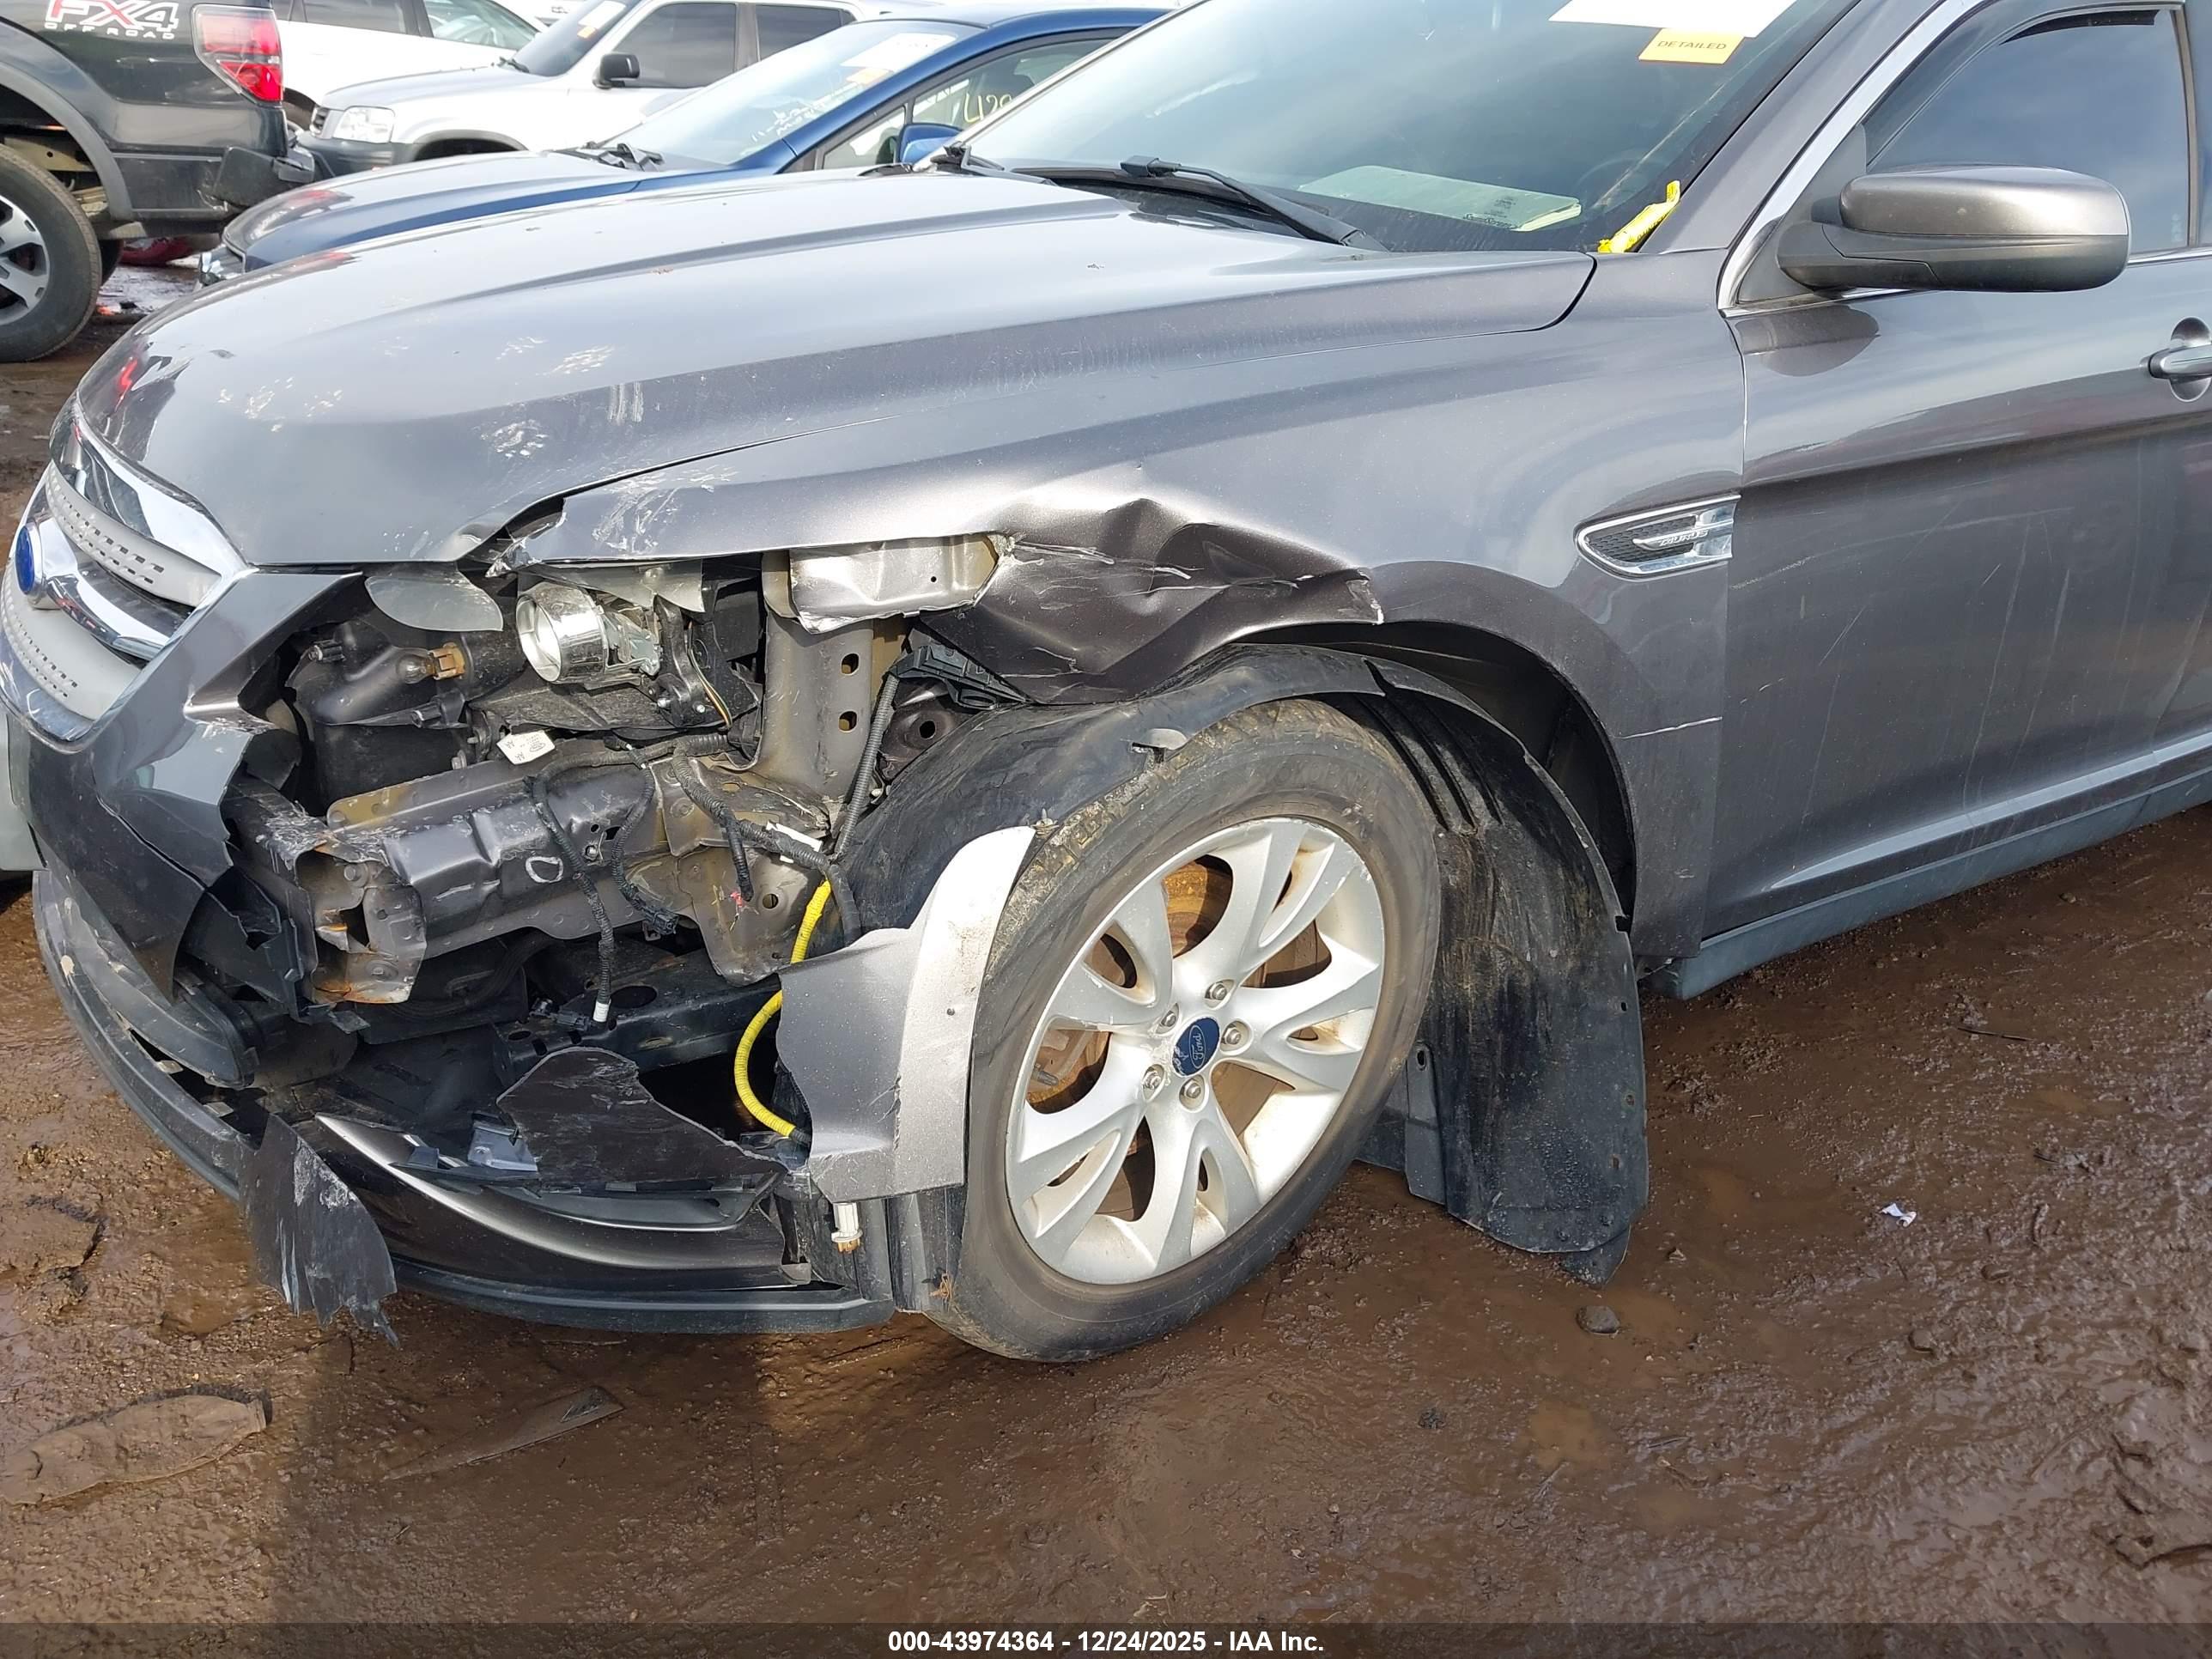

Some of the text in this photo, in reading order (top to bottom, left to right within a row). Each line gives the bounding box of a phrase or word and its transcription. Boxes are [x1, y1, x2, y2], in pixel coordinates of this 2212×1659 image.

[45, 0, 179, 32] FX4
[44, 21, 175, 40] OFF ROAD
[1656, 40, 1727, 50] DETAILED
[1191, 1033, 1204, 1060] Ford
